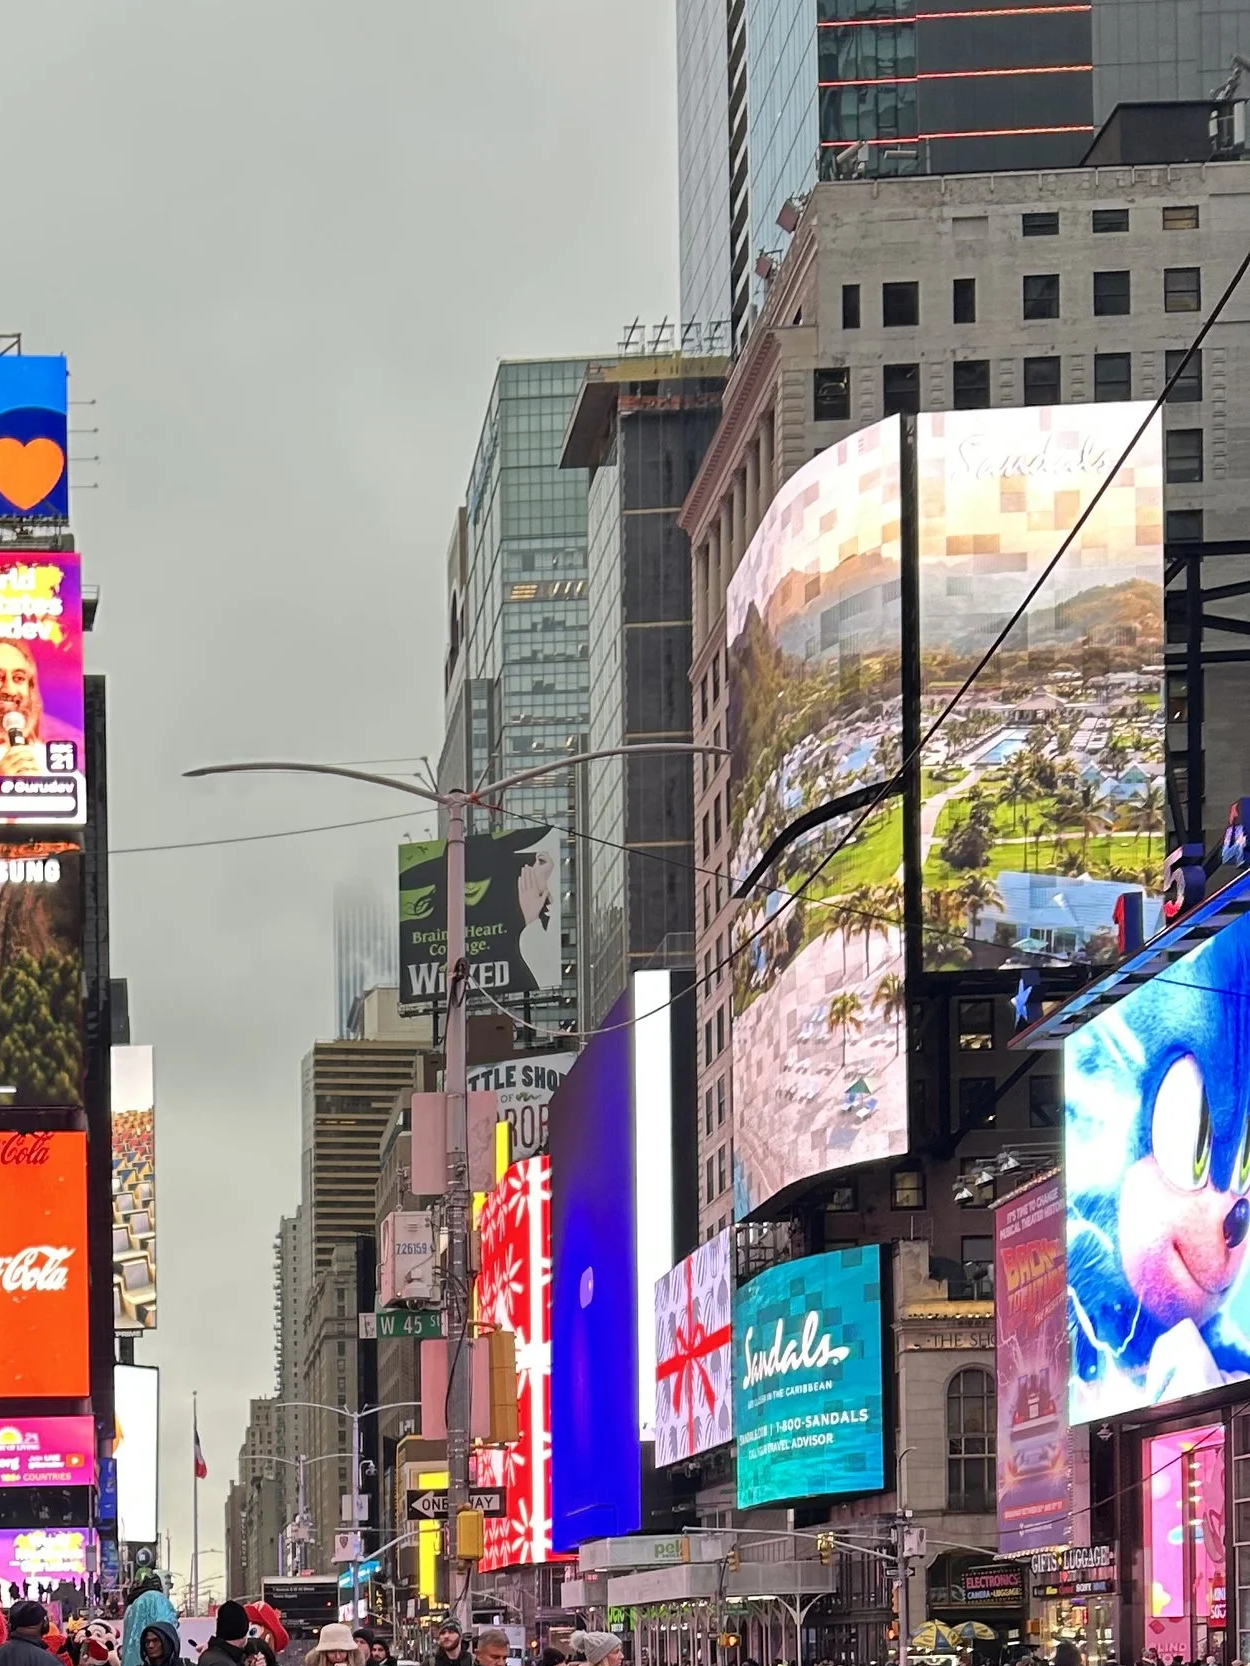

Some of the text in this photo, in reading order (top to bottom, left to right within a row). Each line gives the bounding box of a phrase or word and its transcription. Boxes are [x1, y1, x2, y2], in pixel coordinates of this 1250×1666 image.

[50, 753, 74, 770] 21
[396, 1242, 428, 1255] 726159
[381, 1316, 395, 1335] W
[404, 1316, 422, 1334] 45
[931, 1332, 962, 1347] THE
[785, 1380, 833, 1397] CARIBBEAN
[776, 1408, 869, 1433] 1-800-SANDALS
[791, 1433, 834, 1449] ADVISOR
[23, 1472, 72, 1481] COUNTRIES
[422, 1498, 448, 1511] ONE
[1031, 1546, 1110, 1573] GIFTS LUGGAGE
[966, 1573, 1019, 1588] ELECTRONICS
[967, 1590, 990, 1599] CAMERA
